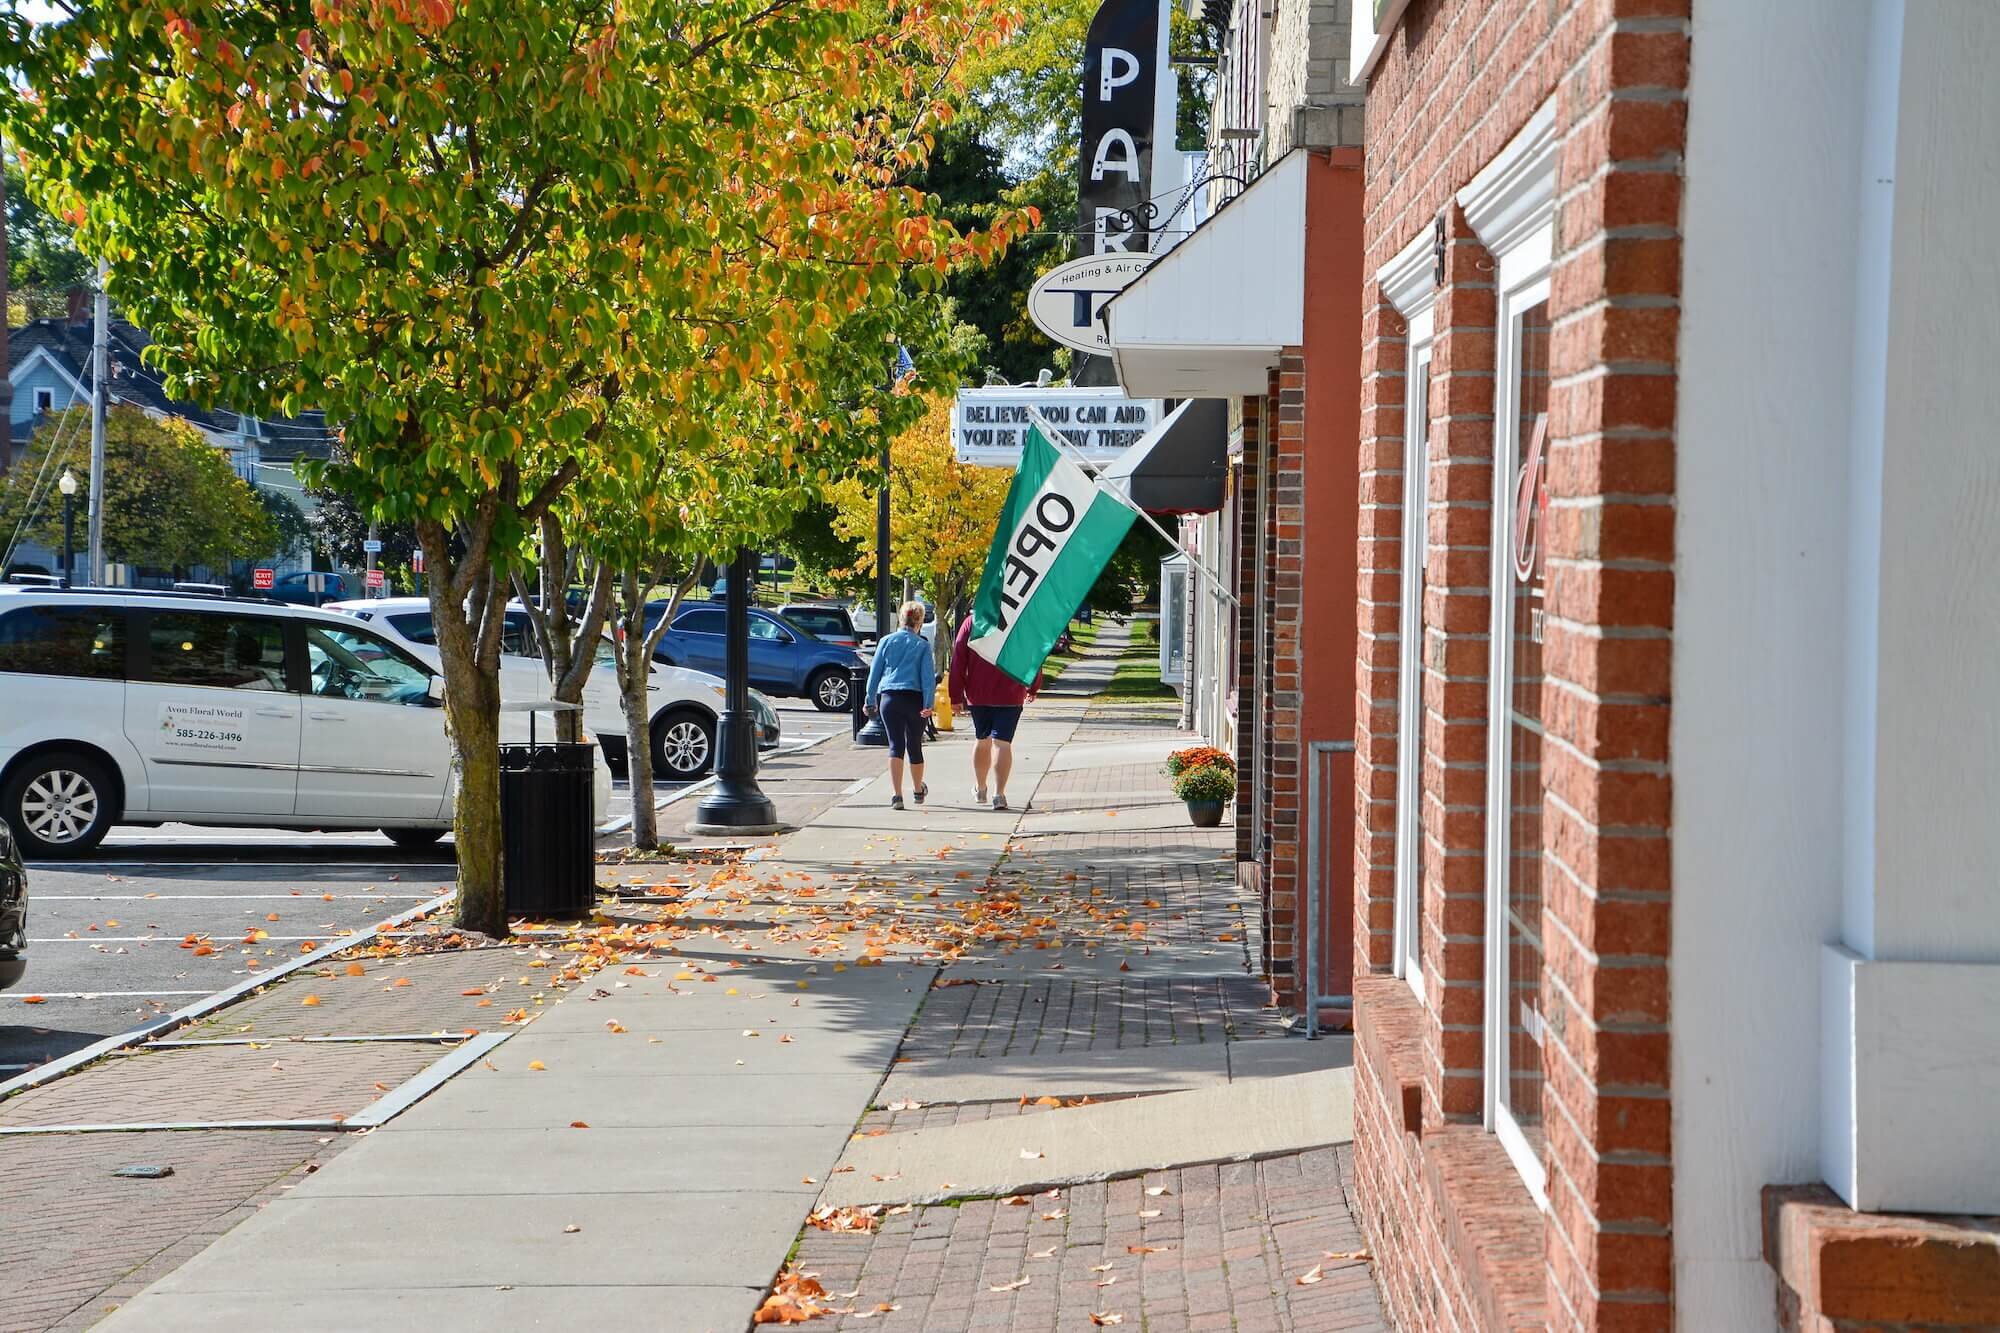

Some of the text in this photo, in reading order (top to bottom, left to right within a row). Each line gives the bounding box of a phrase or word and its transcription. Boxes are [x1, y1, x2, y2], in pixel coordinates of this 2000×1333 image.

[1062, 268, 1101, 284] Heating
[1105, 265, 1112, 273] &
[1116, 264, 1131, 272] Air
[966, 406, 1146, 424] BELIEVE YOU CAN AND
[1097, 429, 1146, 448] THERE
[167, 706, 242, 718] Avon Floral World
[176, 729, 242, 742] 585-226-3496
